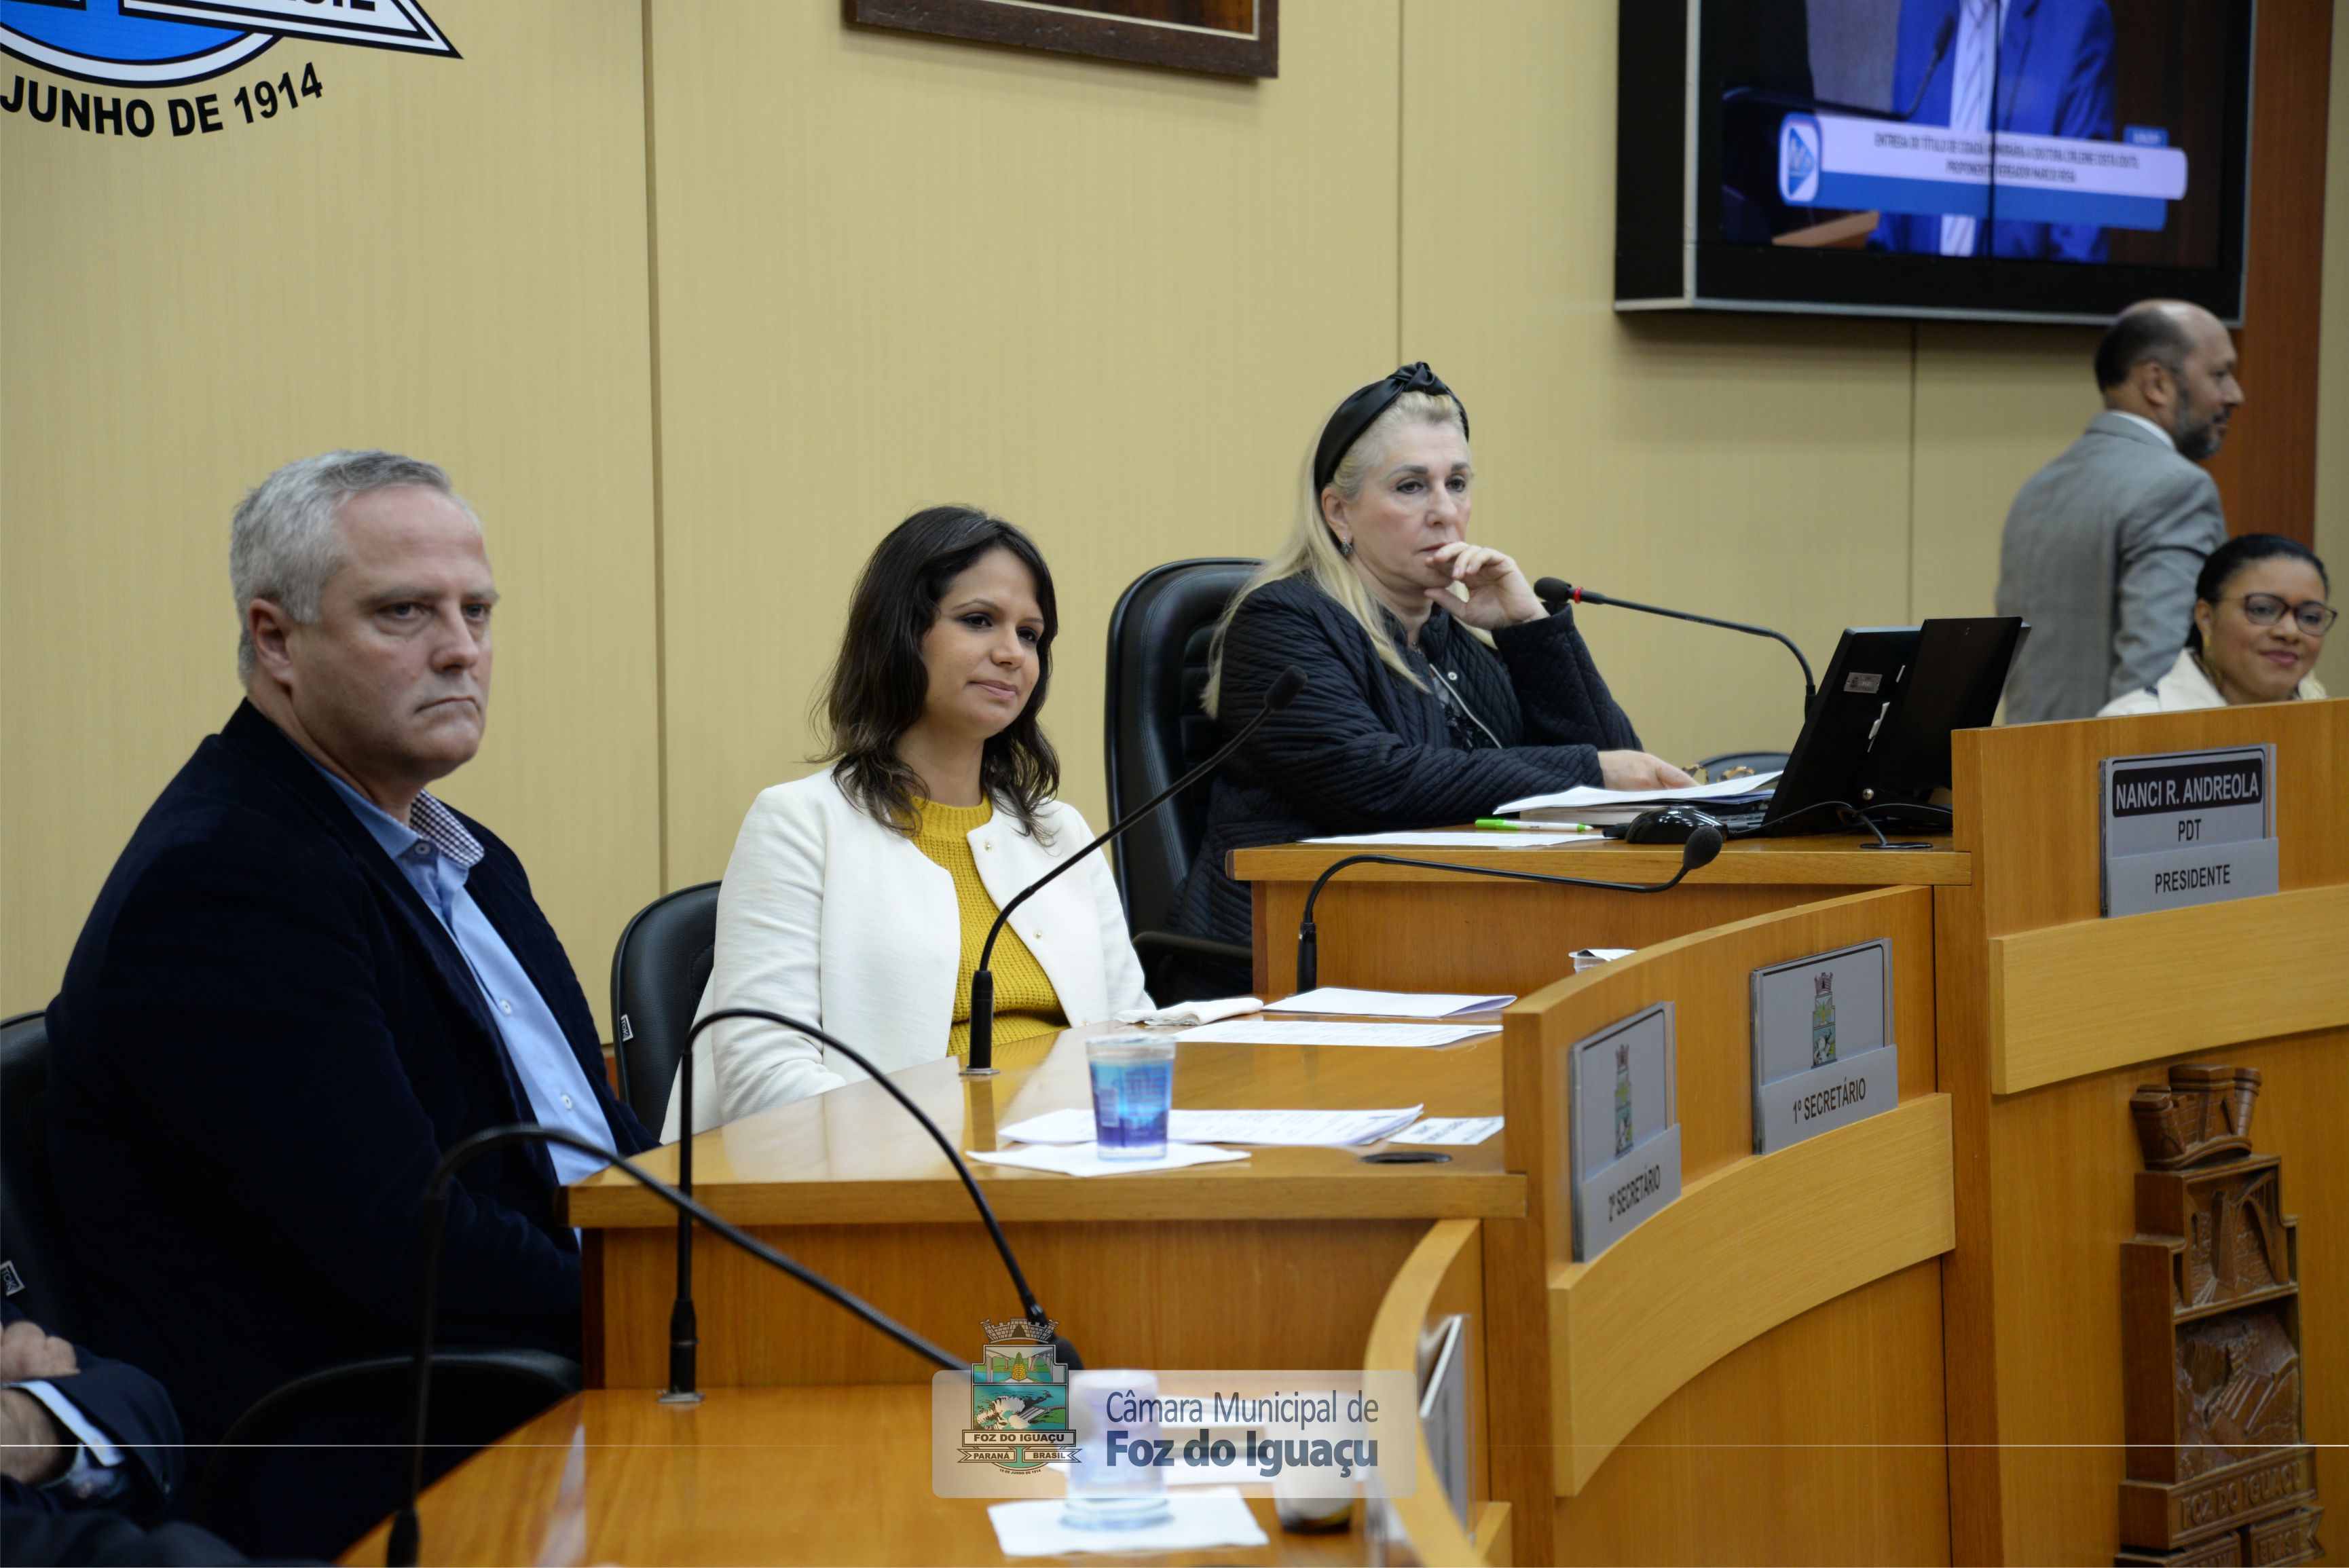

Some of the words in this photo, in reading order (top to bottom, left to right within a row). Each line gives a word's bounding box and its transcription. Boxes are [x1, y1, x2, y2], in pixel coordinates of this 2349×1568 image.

[0, 75, 154, 138] JUNHO
[168, 94, 223, 137] DE
[234, 62, 323, 124] 1914
[2116, 782, 2162, 810] NANCI
[2166, 780, 2180, 806] R.
[2183, 772, 2259, 804] ANDREOLA
[2178, 819, 2201, 842] PDT
[2155, 864, 2231, 894] PRESIDENTE
[1804, 1077, 1866, 1121] SECRETÁRIO
[1617, 1163, 1661, 1216] SECRETÁRIO
